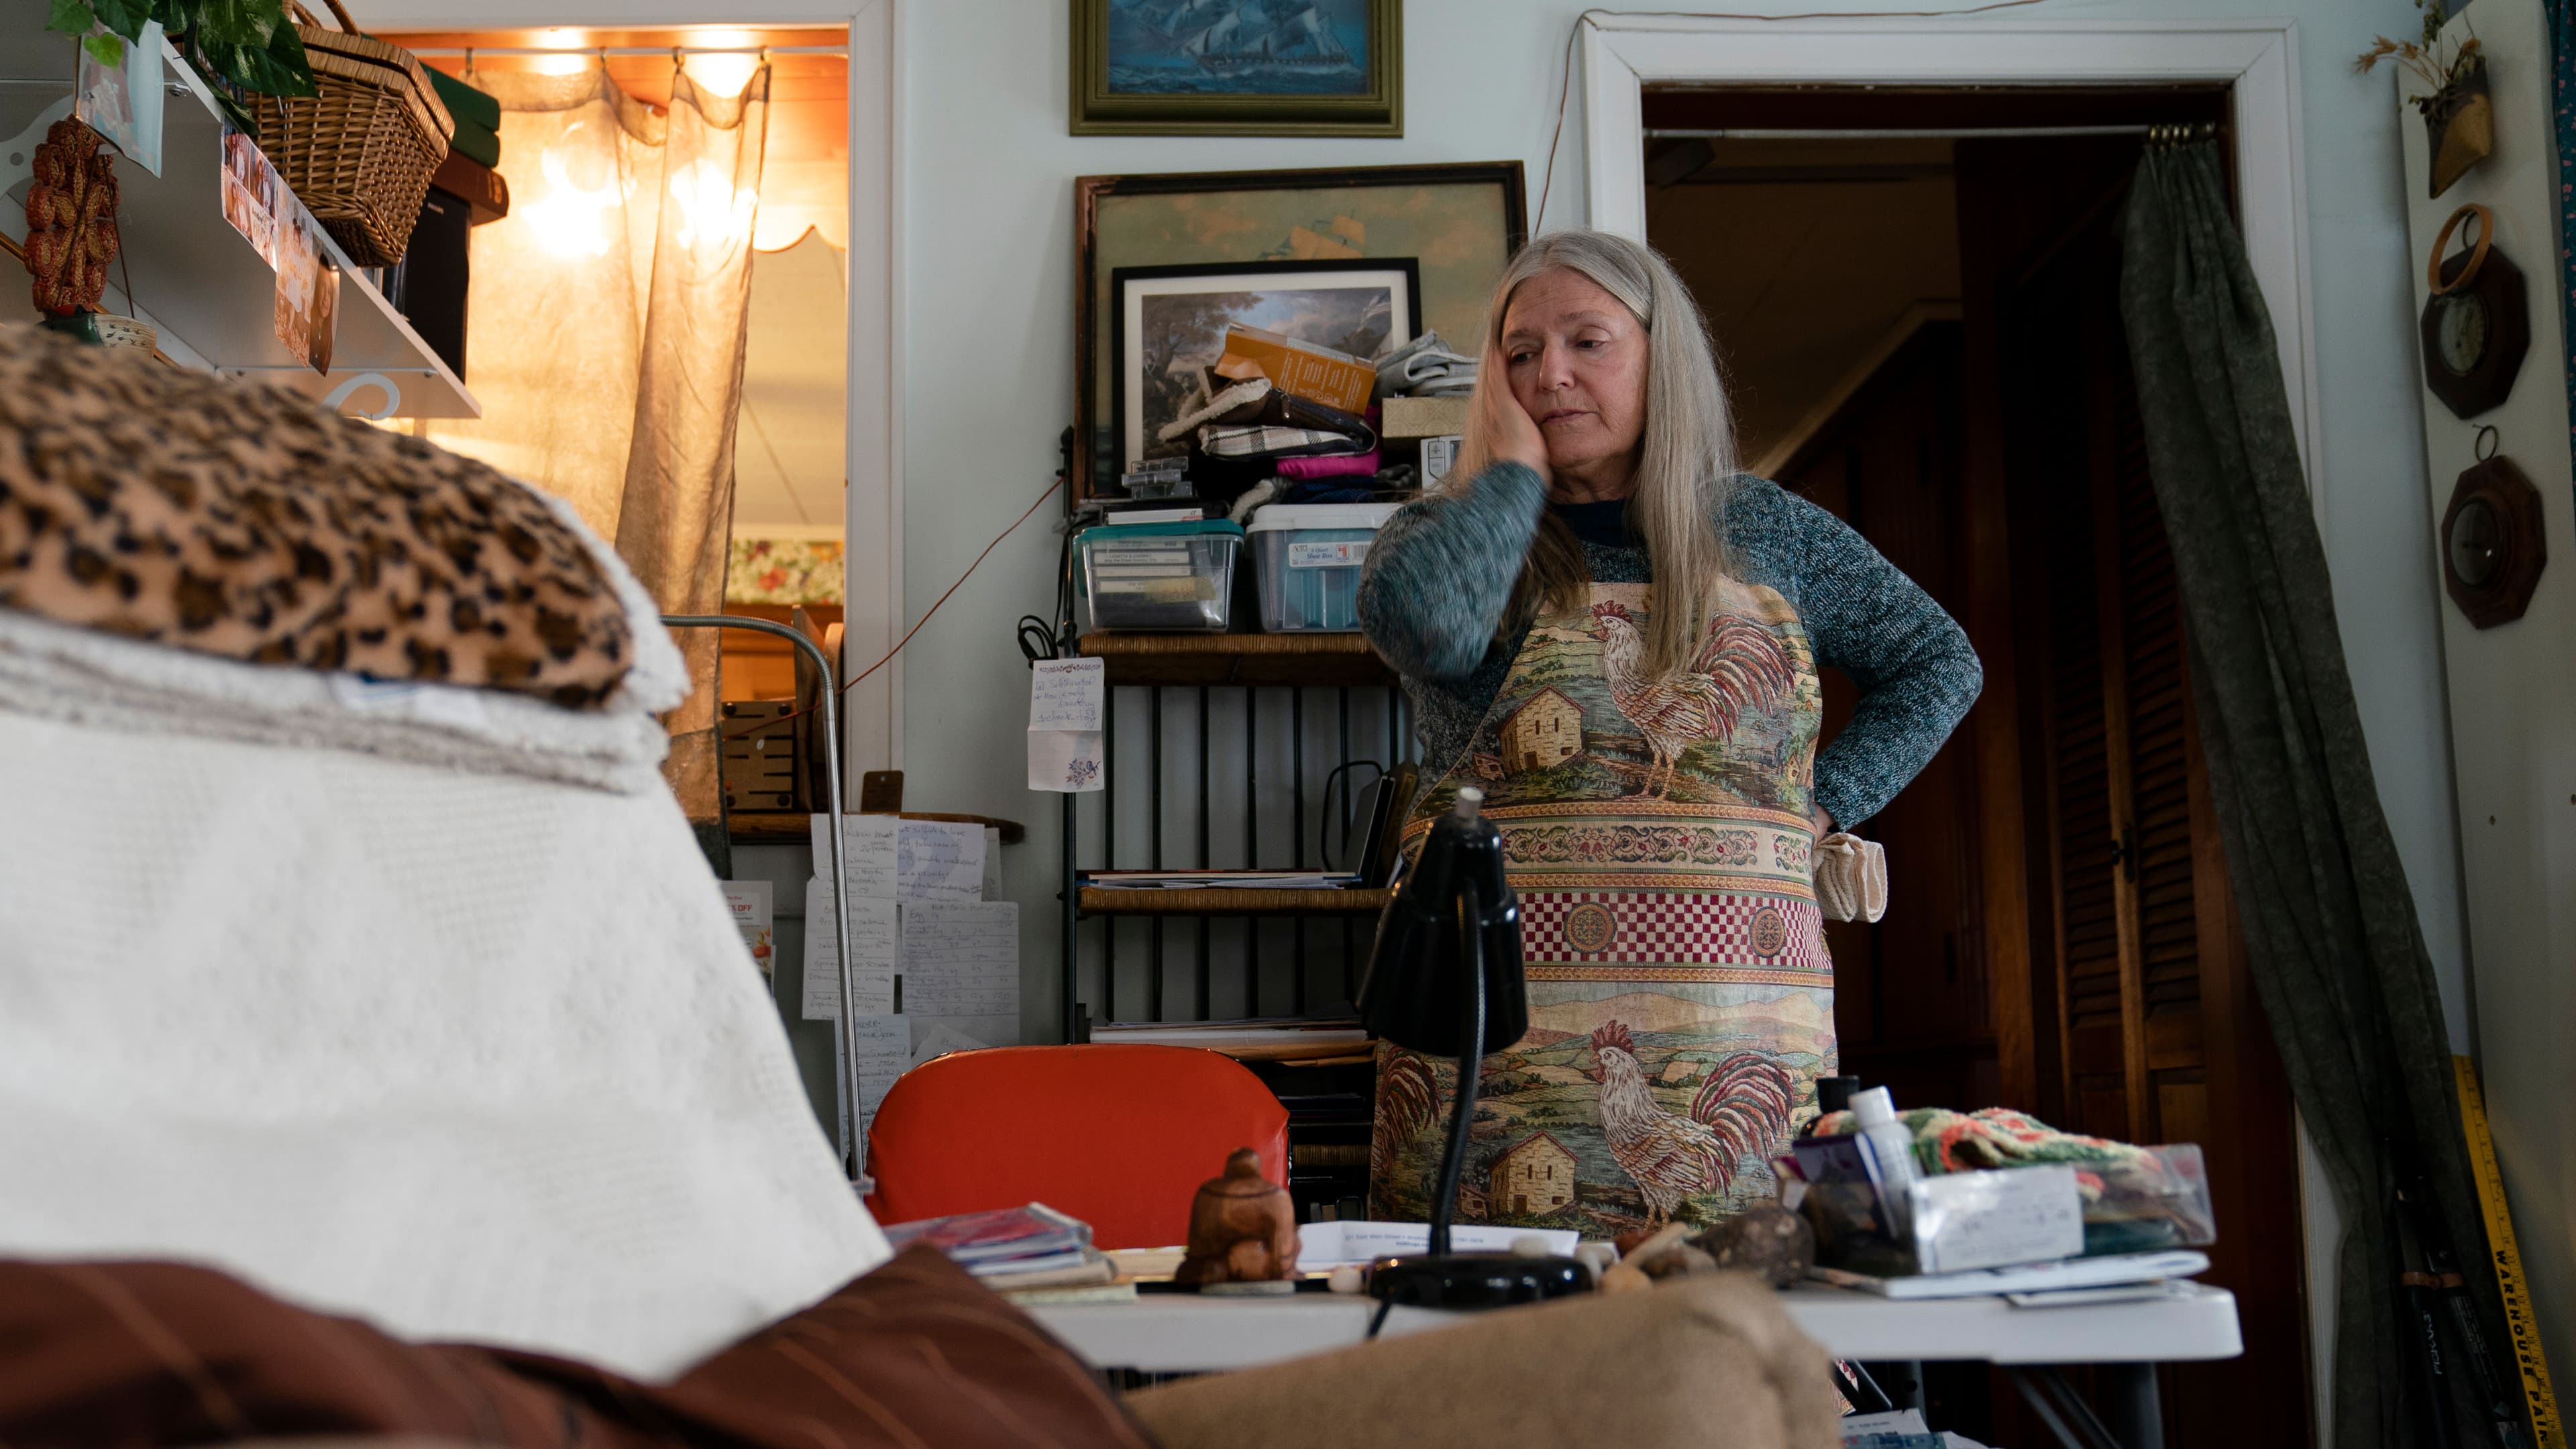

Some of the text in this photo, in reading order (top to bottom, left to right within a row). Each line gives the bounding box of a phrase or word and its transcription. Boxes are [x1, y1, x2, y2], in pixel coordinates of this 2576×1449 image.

[738, 904, 753, 912] OFF
[2496, 1250, 2549, 1449] WAREHOUSE PAIN
